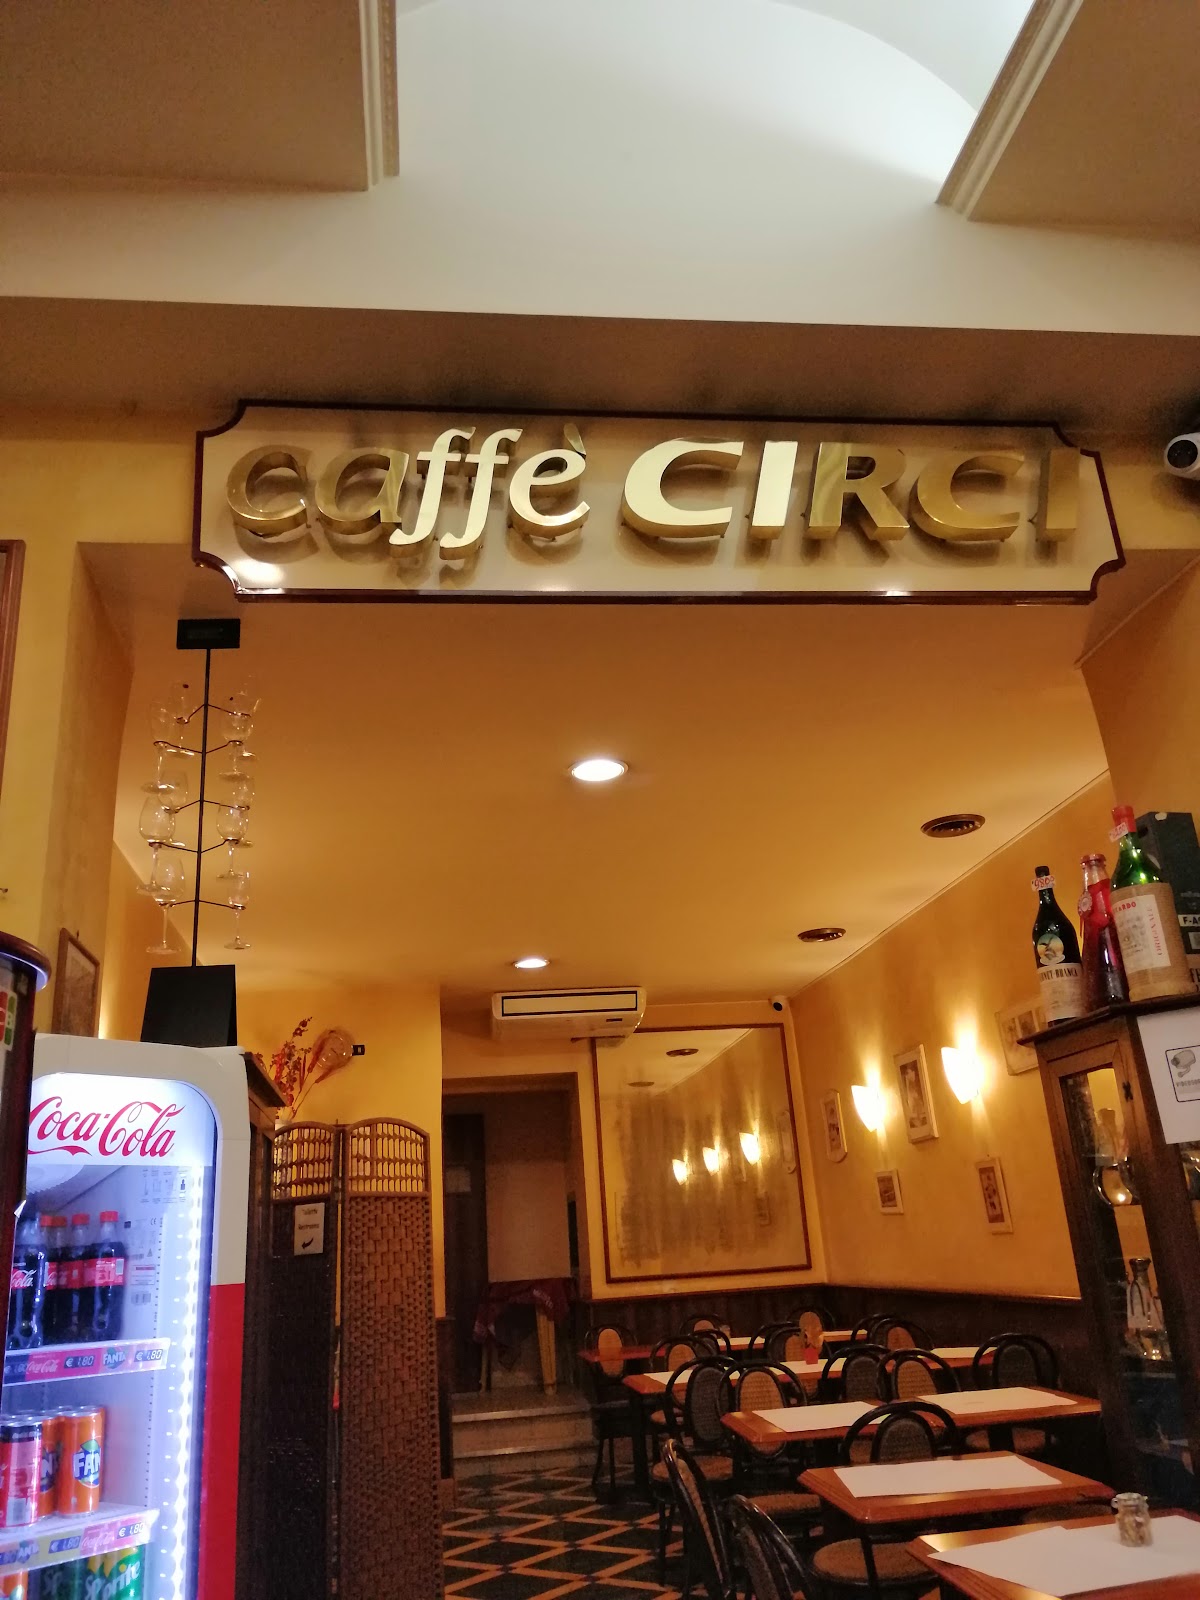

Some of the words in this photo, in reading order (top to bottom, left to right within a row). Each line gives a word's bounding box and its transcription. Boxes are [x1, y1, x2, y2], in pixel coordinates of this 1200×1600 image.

[226, 423, 591, 560] caffè
[619, 437, 1082, 543] CIRCI
[28, 1096, 186, 1157] Coca-Cola
[102, 1352, 126, 1365] FANTA
